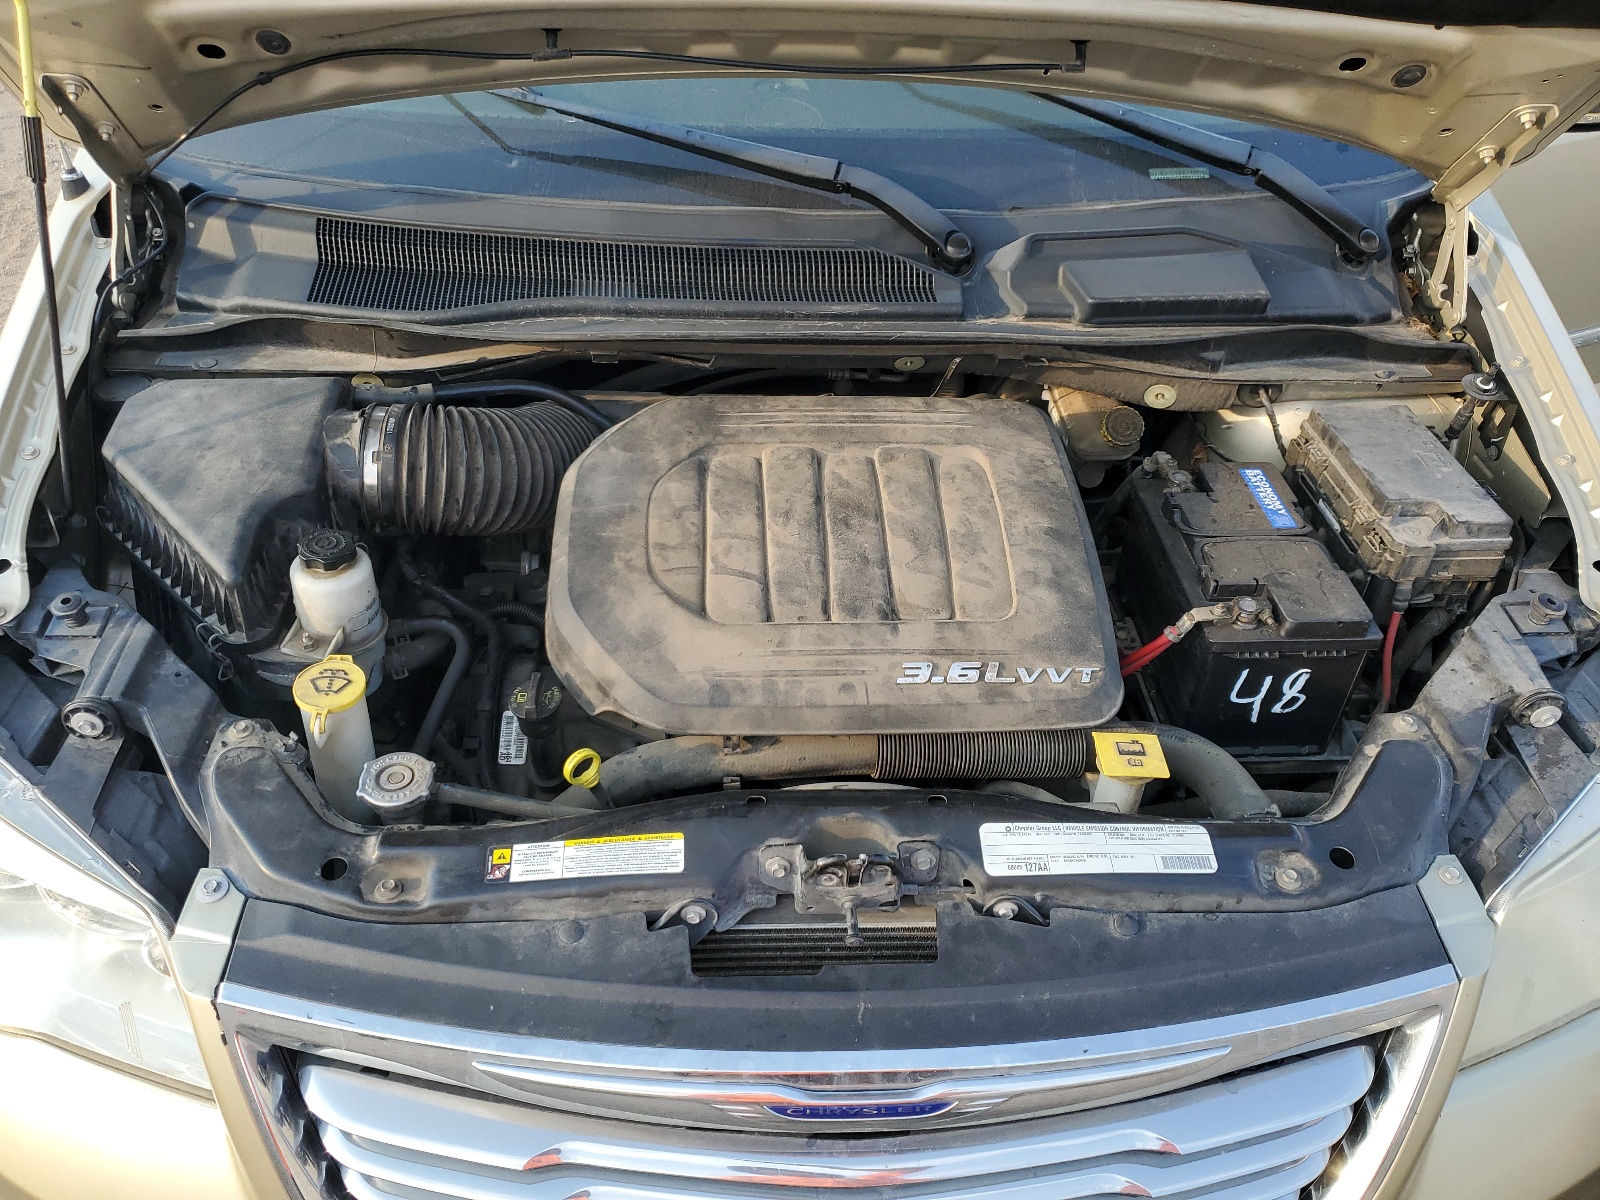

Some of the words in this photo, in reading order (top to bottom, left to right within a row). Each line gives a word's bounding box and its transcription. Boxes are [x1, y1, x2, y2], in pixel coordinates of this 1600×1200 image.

[1244, 469, 1277, 512] BATTERY
[1254, 469, 1288, 516] ECONOMY
[1230, 668, 1313, 725] 48
[1024, 862, 1049, 873] 127AA
[786, 1105, 933, 1116] CHRYSLER
